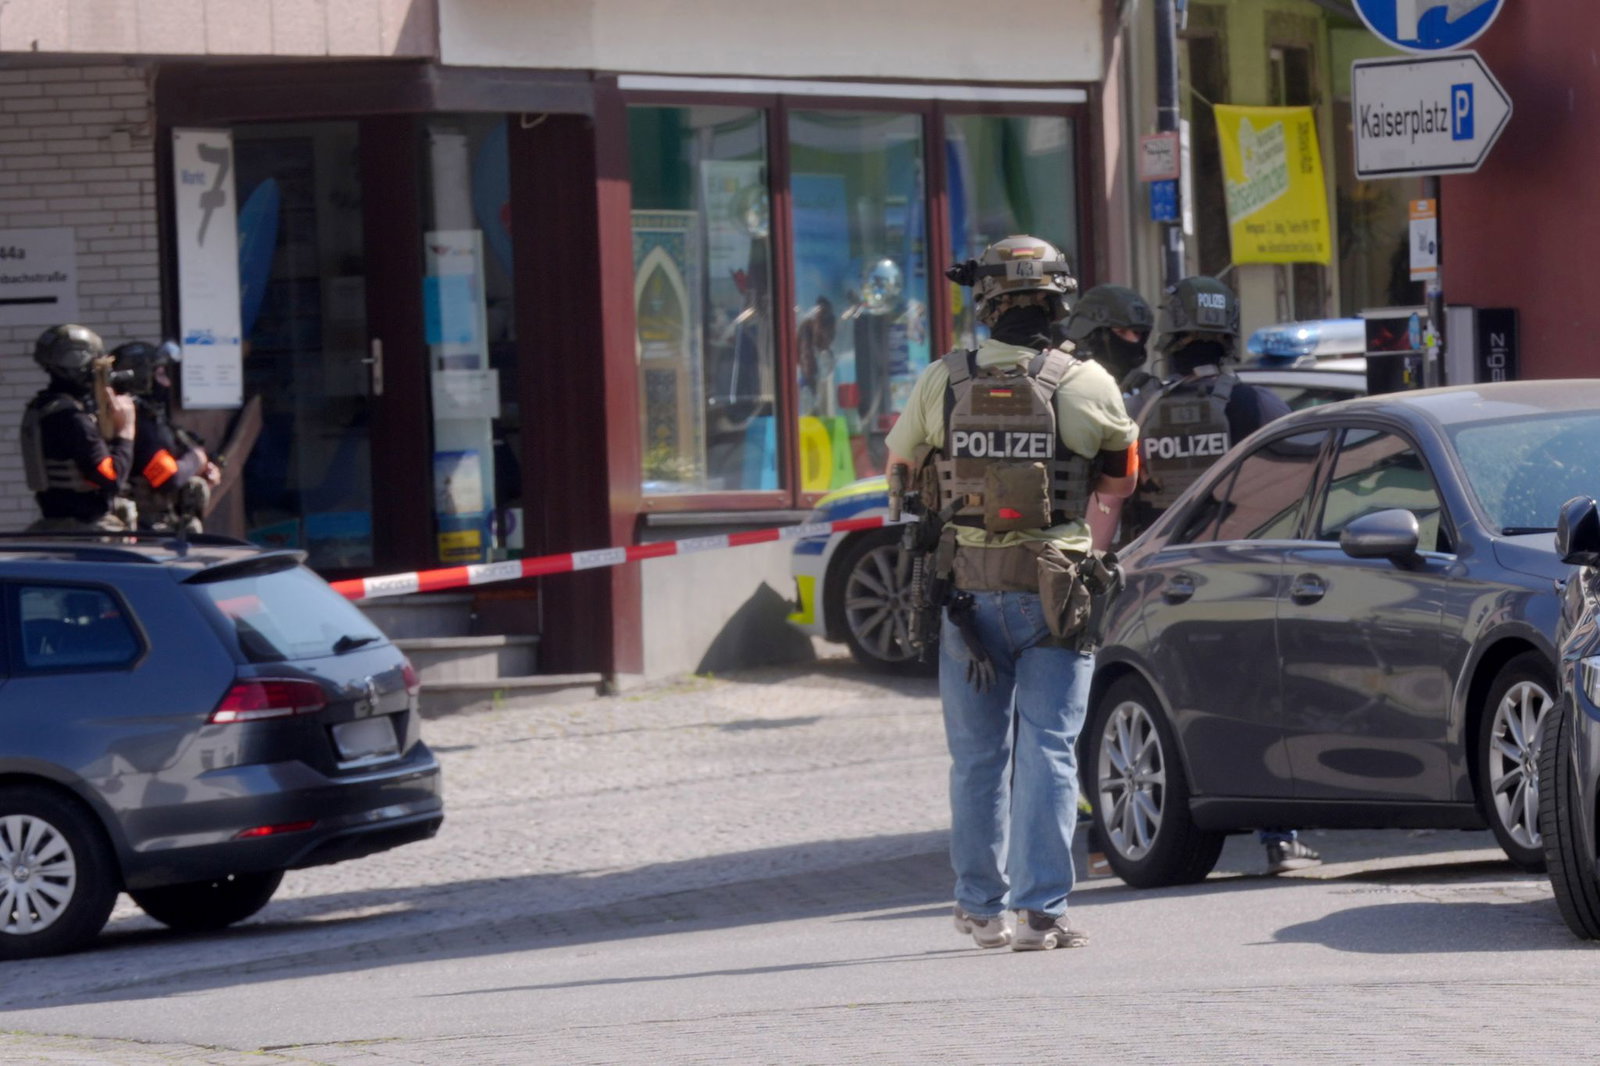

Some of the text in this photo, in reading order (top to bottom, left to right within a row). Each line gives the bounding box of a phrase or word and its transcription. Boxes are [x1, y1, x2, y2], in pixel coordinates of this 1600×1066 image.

[1360, 89, 1470, 145] Kaiserplatz P
[952, 431, 1053, 458] POLIZEI
[1144, 432, 1230, 459] POLIZEI
